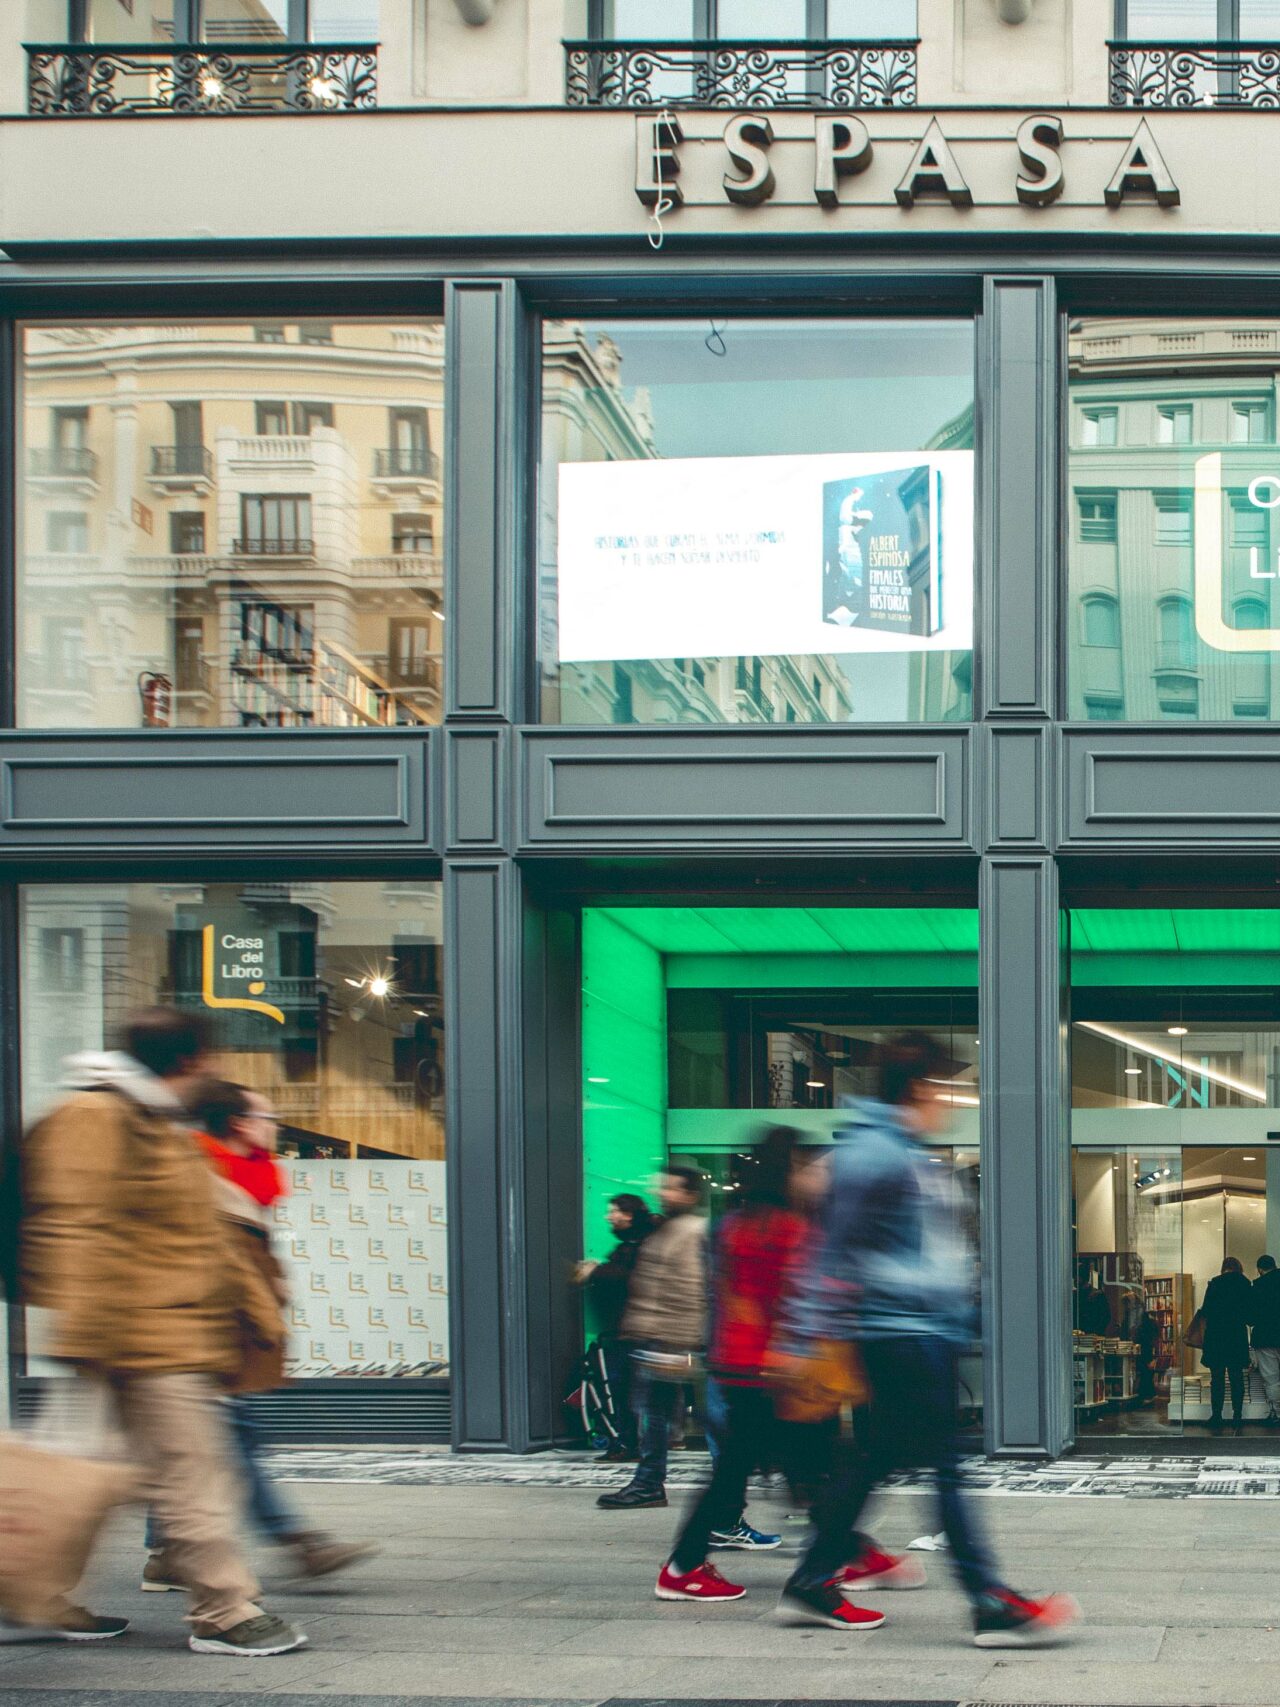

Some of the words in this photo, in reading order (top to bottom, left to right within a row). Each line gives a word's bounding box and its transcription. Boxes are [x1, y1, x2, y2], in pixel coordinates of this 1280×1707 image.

[635, 113, 1180, 208] ESPASA
[869, 535, 899, 551] ALBERT
[869, 551, 910, 567] ESPINOSA
[869, 569, 904, 586] FINALES
[869, 594, 909, 612] HISTORIA
[222, 934, 264, 949] Casa
[241, 952, 264, 963] del
[222, 964, 263, 979] Libro
